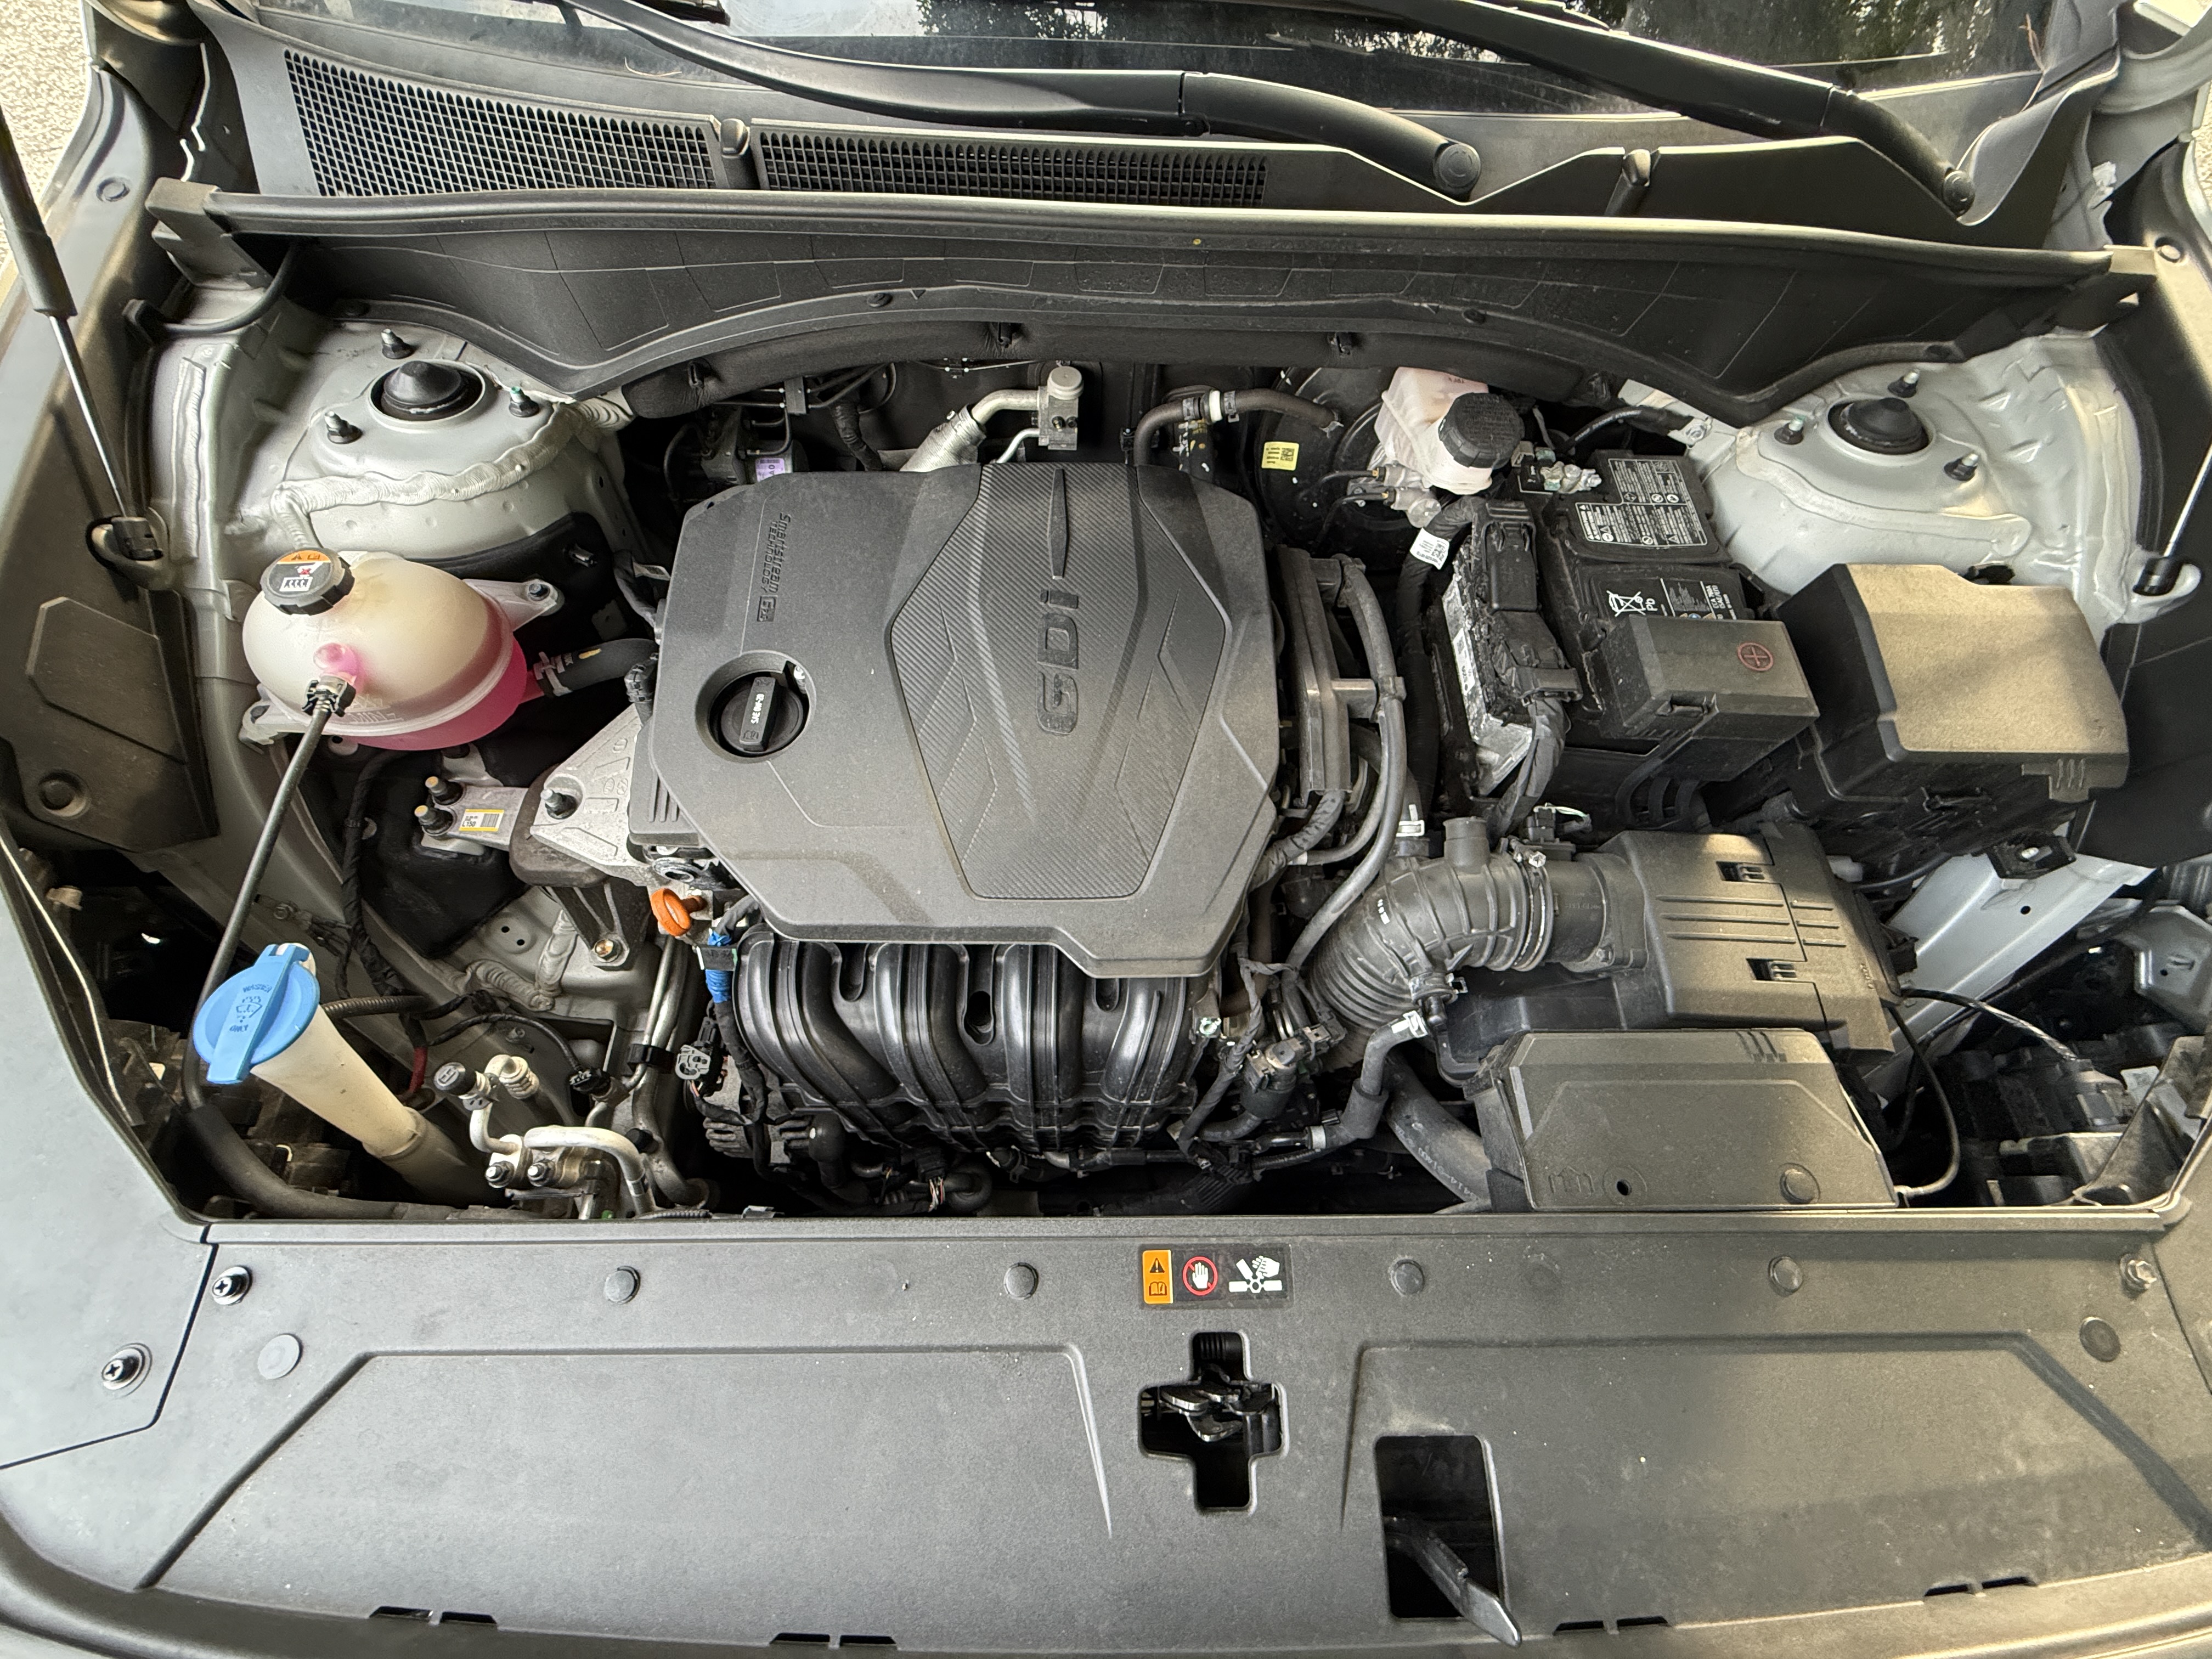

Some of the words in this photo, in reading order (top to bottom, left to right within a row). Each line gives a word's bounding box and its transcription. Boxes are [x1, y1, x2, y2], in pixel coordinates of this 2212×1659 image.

[761, 521, 777, 593] TECHNOLOGY
[769, 512, 791, 593] Smartstream
[1645, 597, 1658, 611] Pb
[750, 712, 761, 724] SAE
